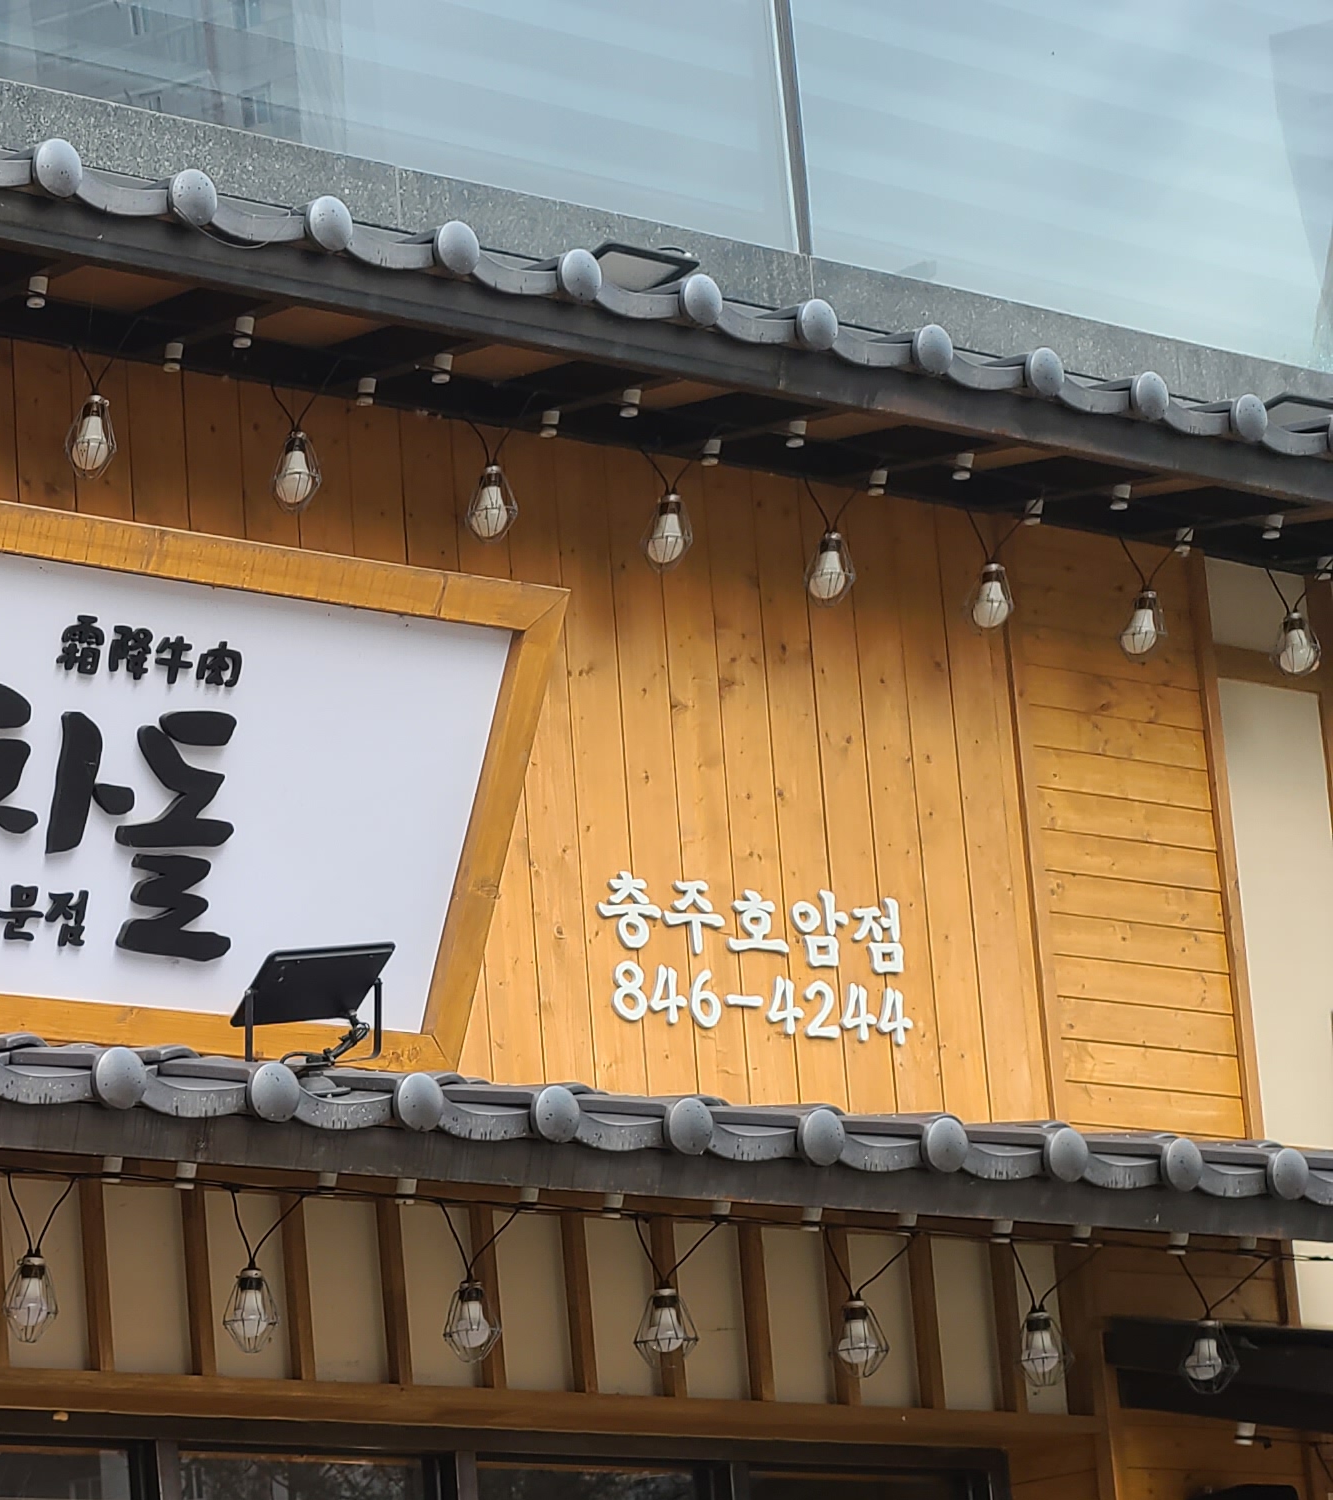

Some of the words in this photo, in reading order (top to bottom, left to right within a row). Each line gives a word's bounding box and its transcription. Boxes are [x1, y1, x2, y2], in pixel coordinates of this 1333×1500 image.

[56, 615, 242, 687] 霜降牛肉
[596, 870, 904, 974] 충주호암점
[611, 960, 913, 1046] 846-4244
